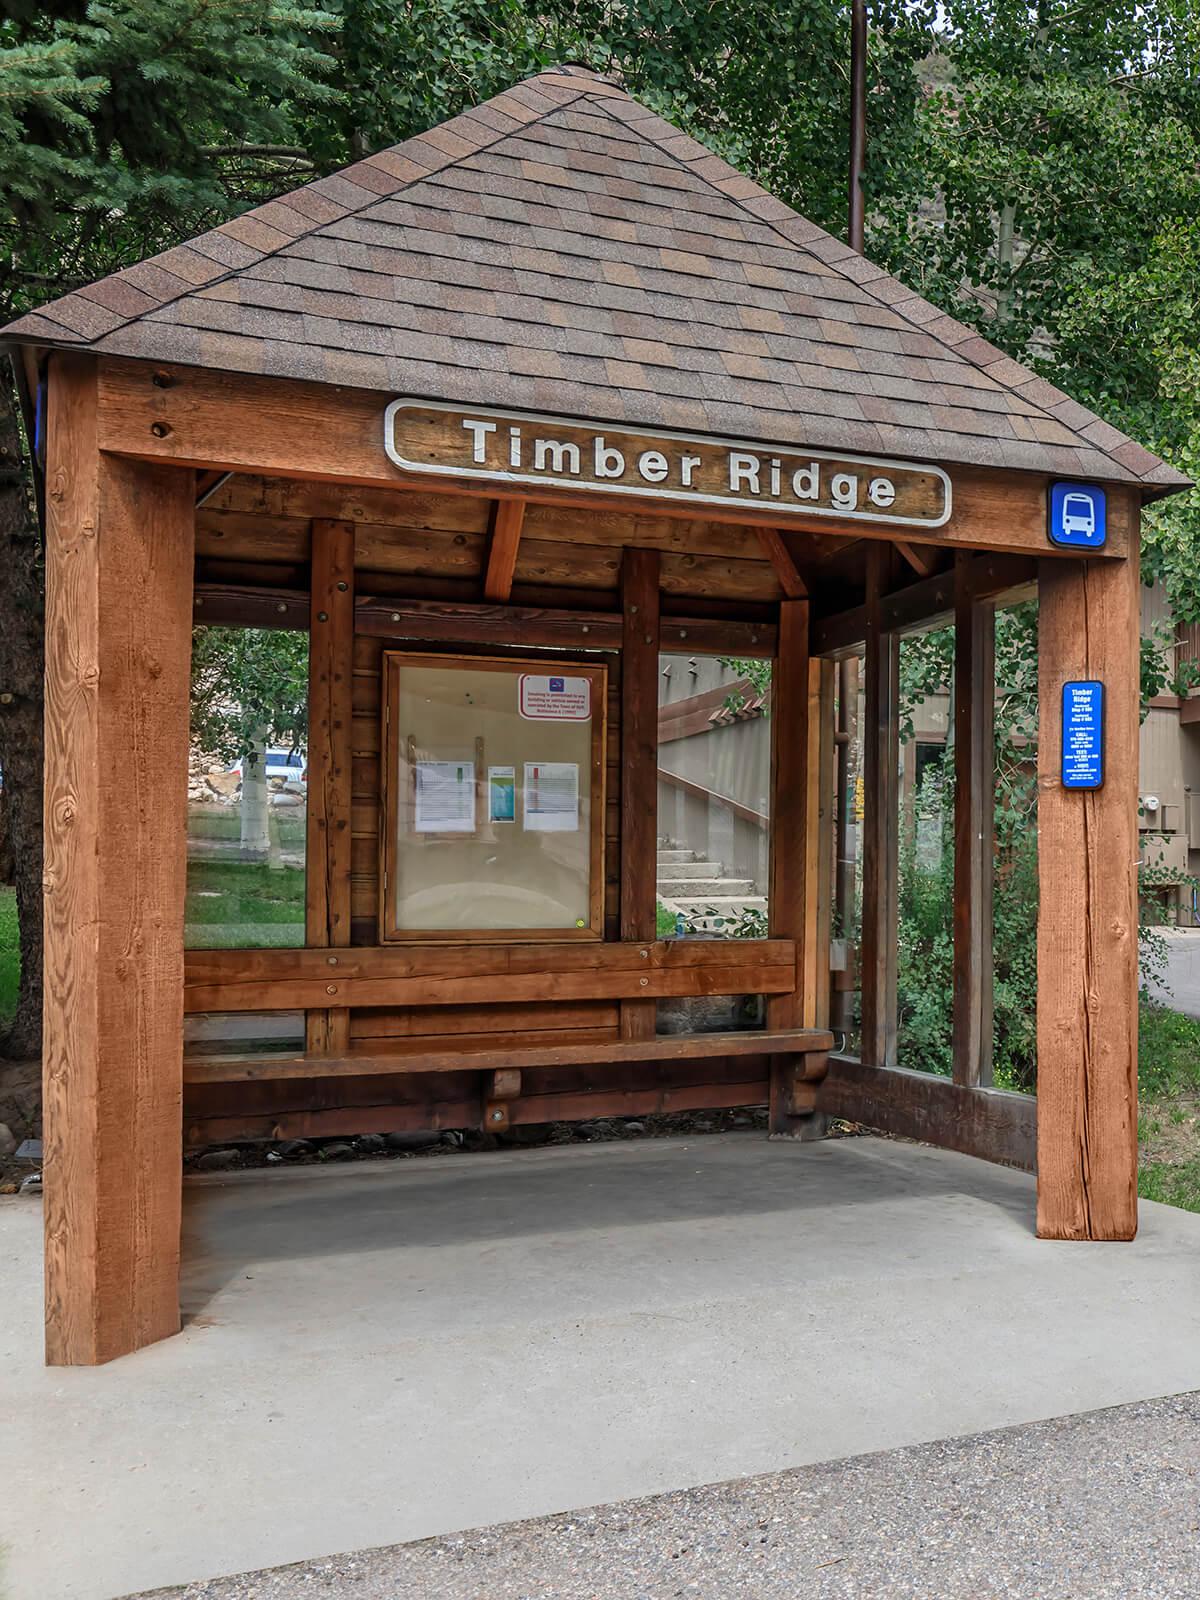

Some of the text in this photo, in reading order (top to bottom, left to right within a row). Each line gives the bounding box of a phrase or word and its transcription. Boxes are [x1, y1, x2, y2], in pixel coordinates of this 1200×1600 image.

[462, 418, 896, 511] Timber Ridge
[1073, 695, 1091, 703] Ridge
